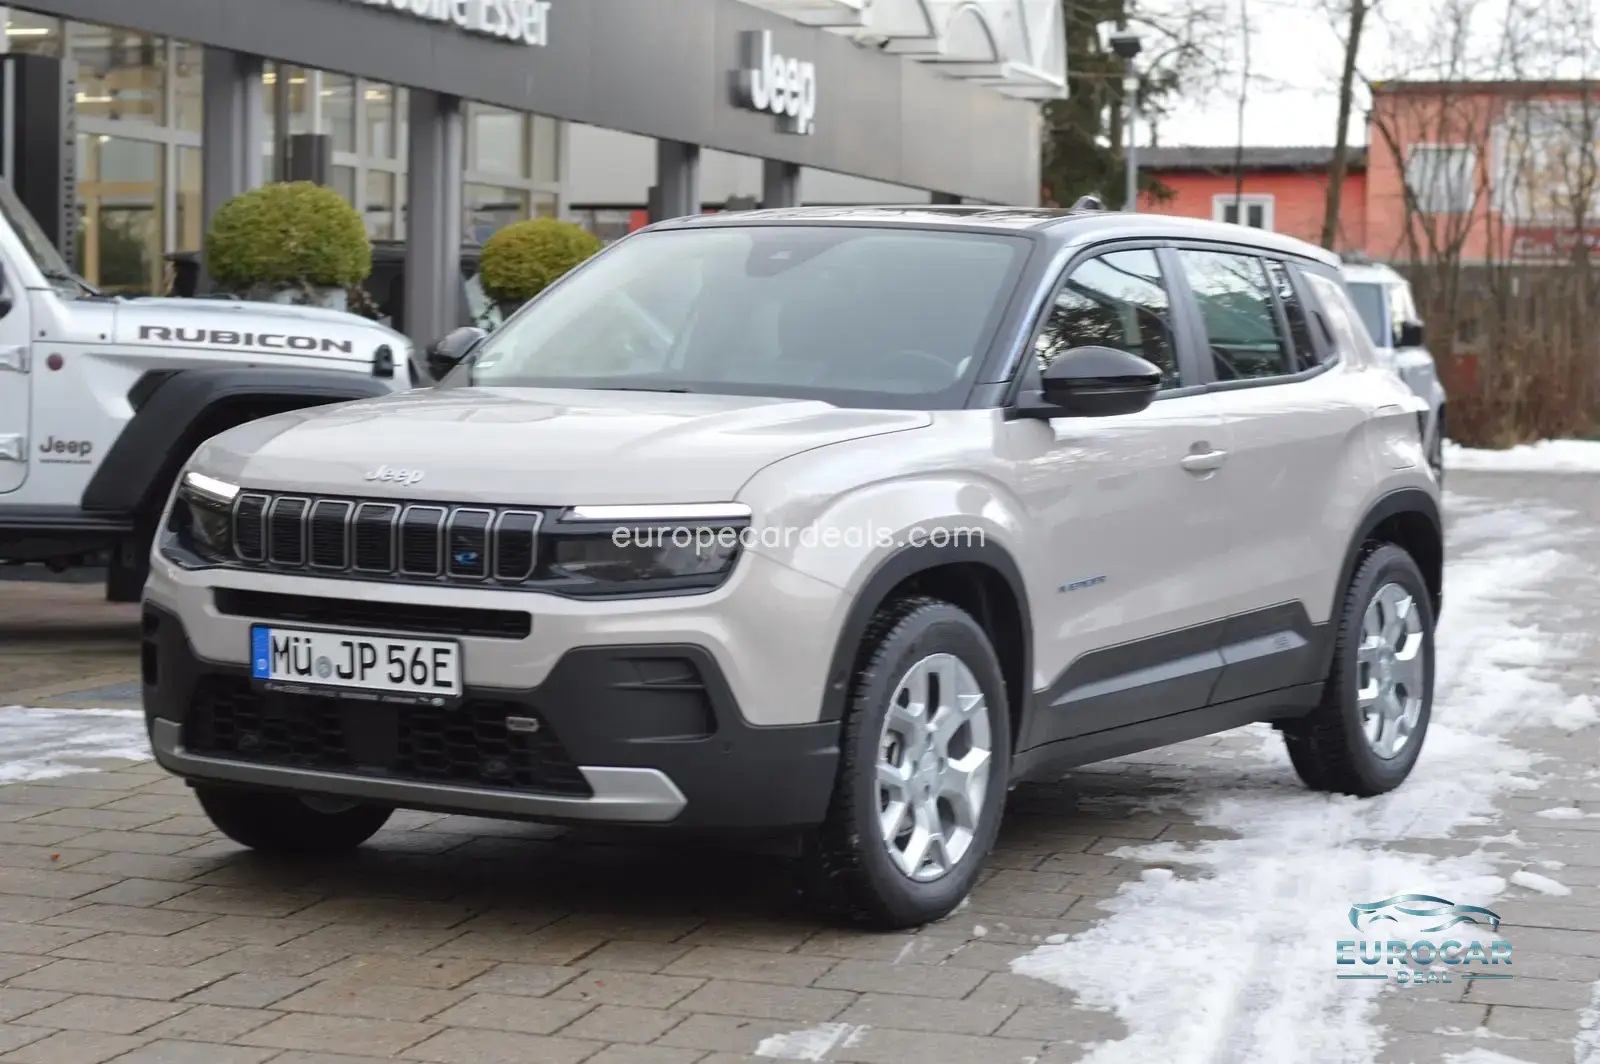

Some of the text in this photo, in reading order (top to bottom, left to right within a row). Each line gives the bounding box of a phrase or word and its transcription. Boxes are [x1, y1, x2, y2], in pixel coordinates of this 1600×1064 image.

[750, 30, 815, 134] Jeep
[138, 325, 353, 353] RUBICON
[39, 435, 92, 457] Jeep
[364, 464, 425, 488] Jeep
[271, 635, 453, 688] MÜ JP 56E
